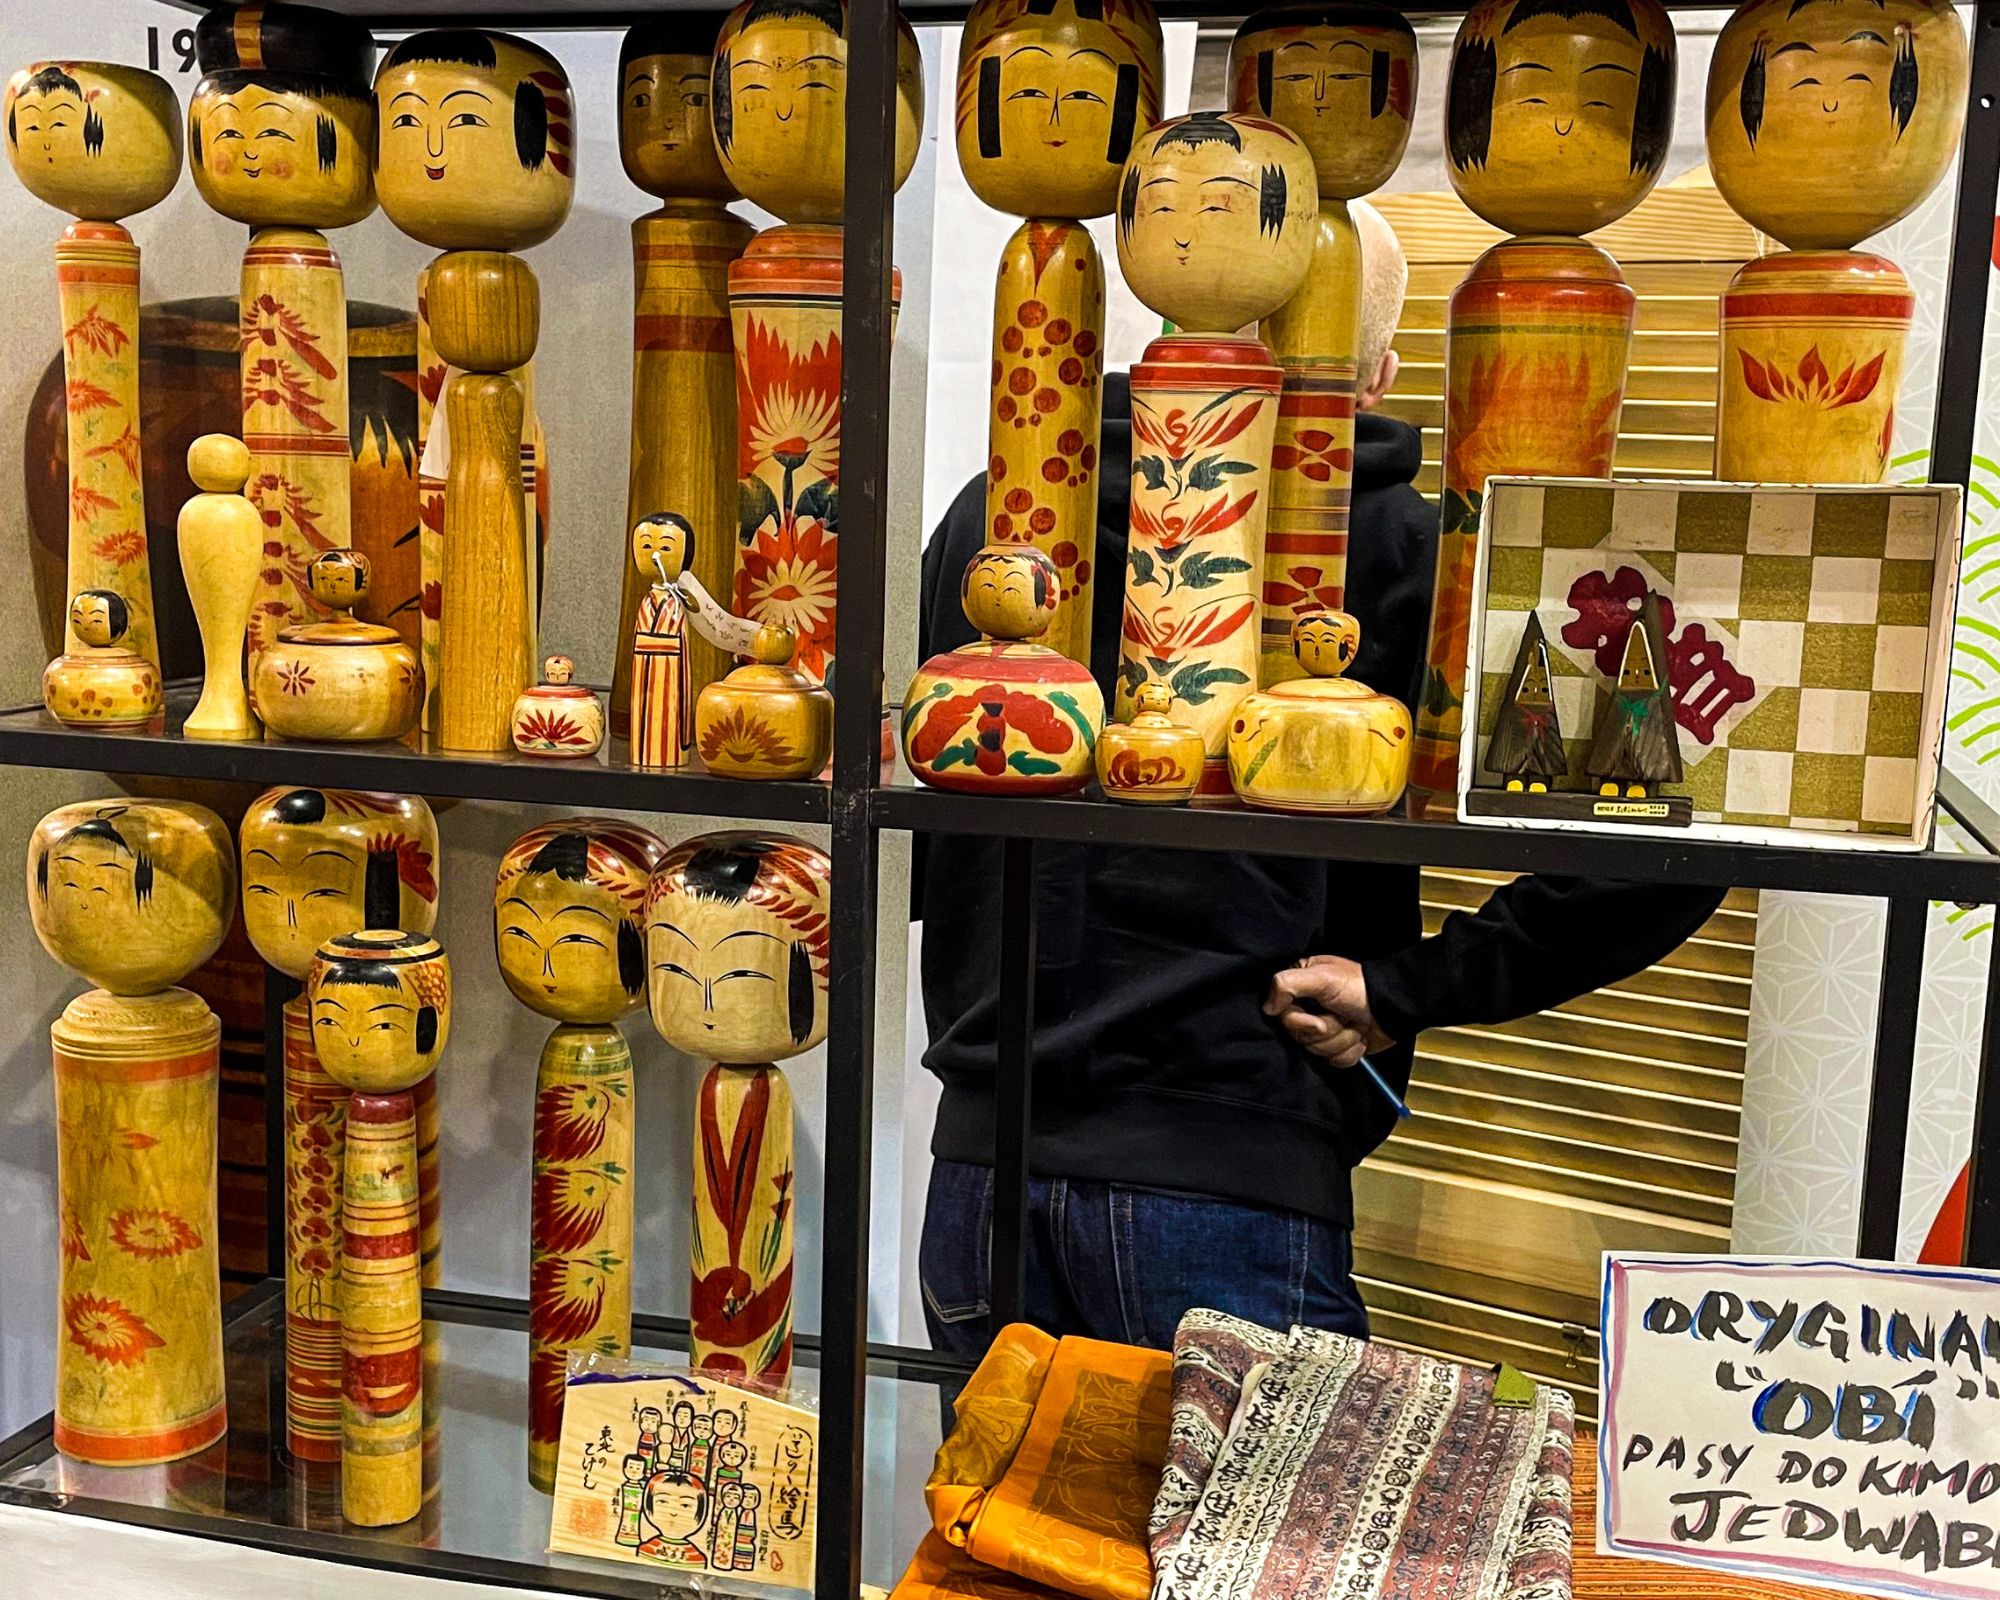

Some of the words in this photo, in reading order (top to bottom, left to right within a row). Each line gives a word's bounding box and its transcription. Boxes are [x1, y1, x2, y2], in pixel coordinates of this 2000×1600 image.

[147, 27, 196, 73] 19
[582, 1442, 598, 1490] こけし
[596, 1424, 616, 1468] 東北の
[1622, 1433, 1753, 1484] PASY
[1777, 1450, 1847, 1488] DO
[1669, 1490, 2000, 1573] JEDWAB
